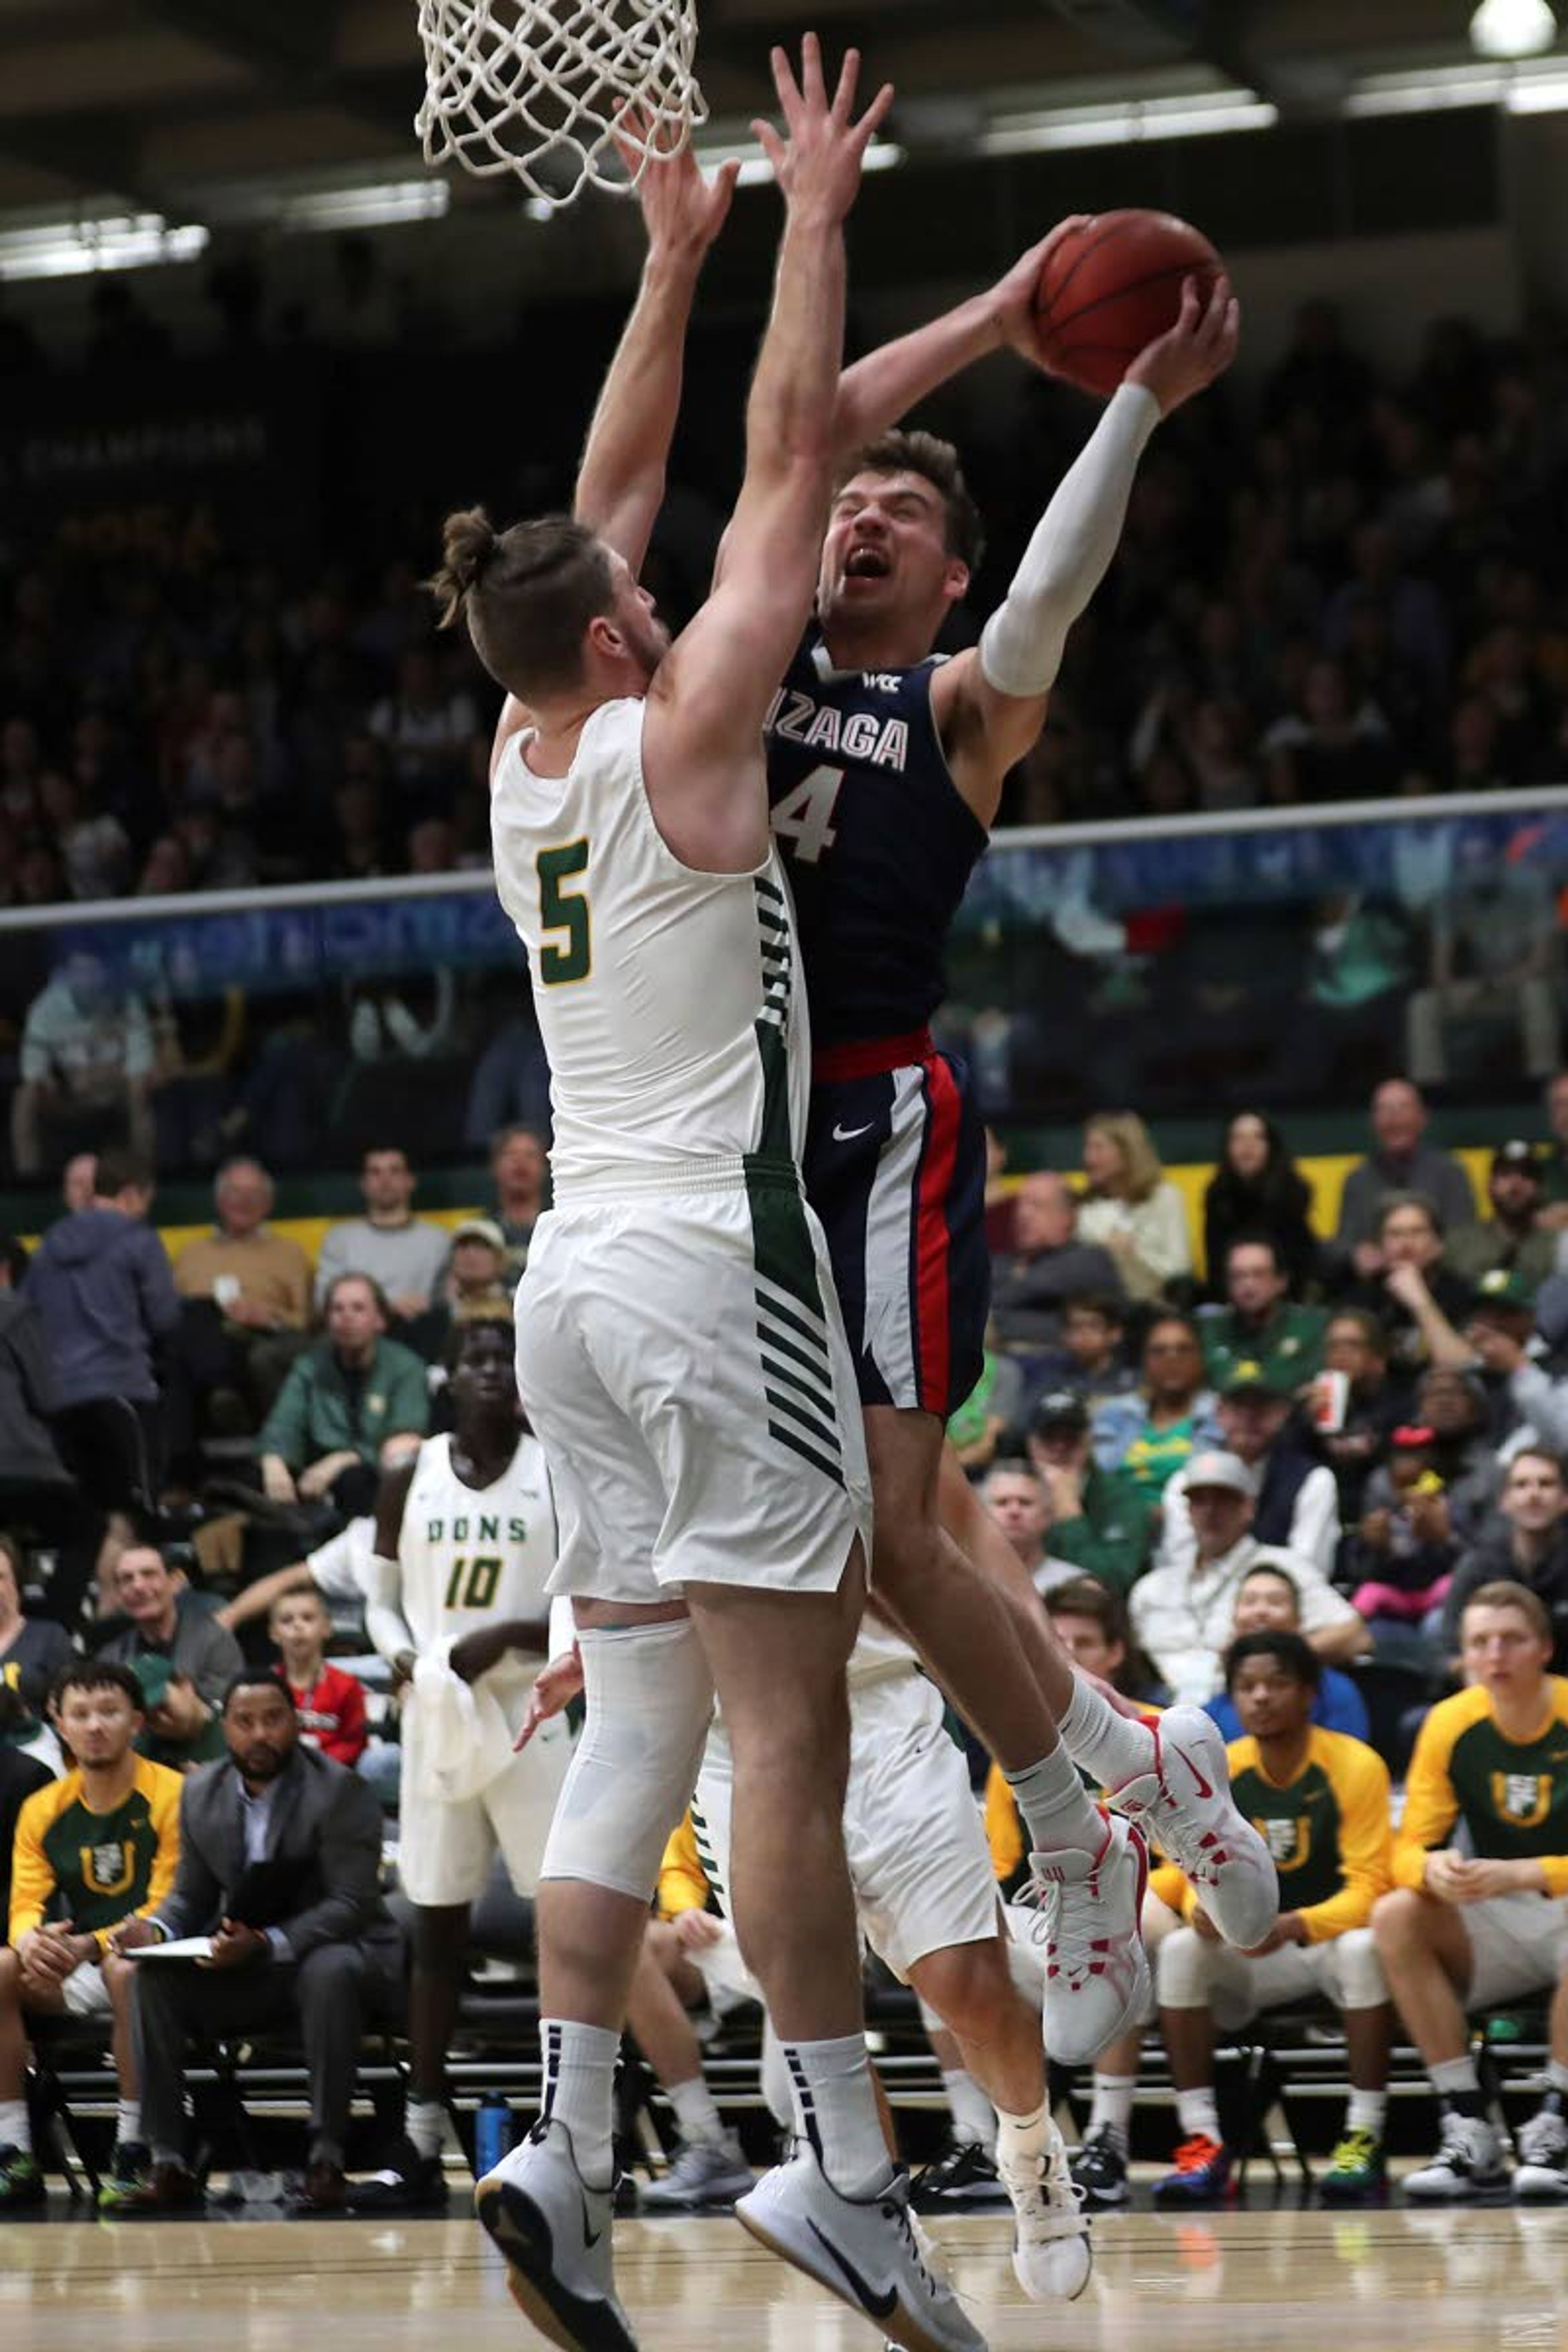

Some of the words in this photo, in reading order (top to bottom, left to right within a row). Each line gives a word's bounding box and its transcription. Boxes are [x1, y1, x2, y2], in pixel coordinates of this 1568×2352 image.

[862, 672, 903, 693] WCC
[536, 835, 593, 988] 5
[428, 1514, 528, 1543] DONS
[444, 1557, 503, 1610] 10
